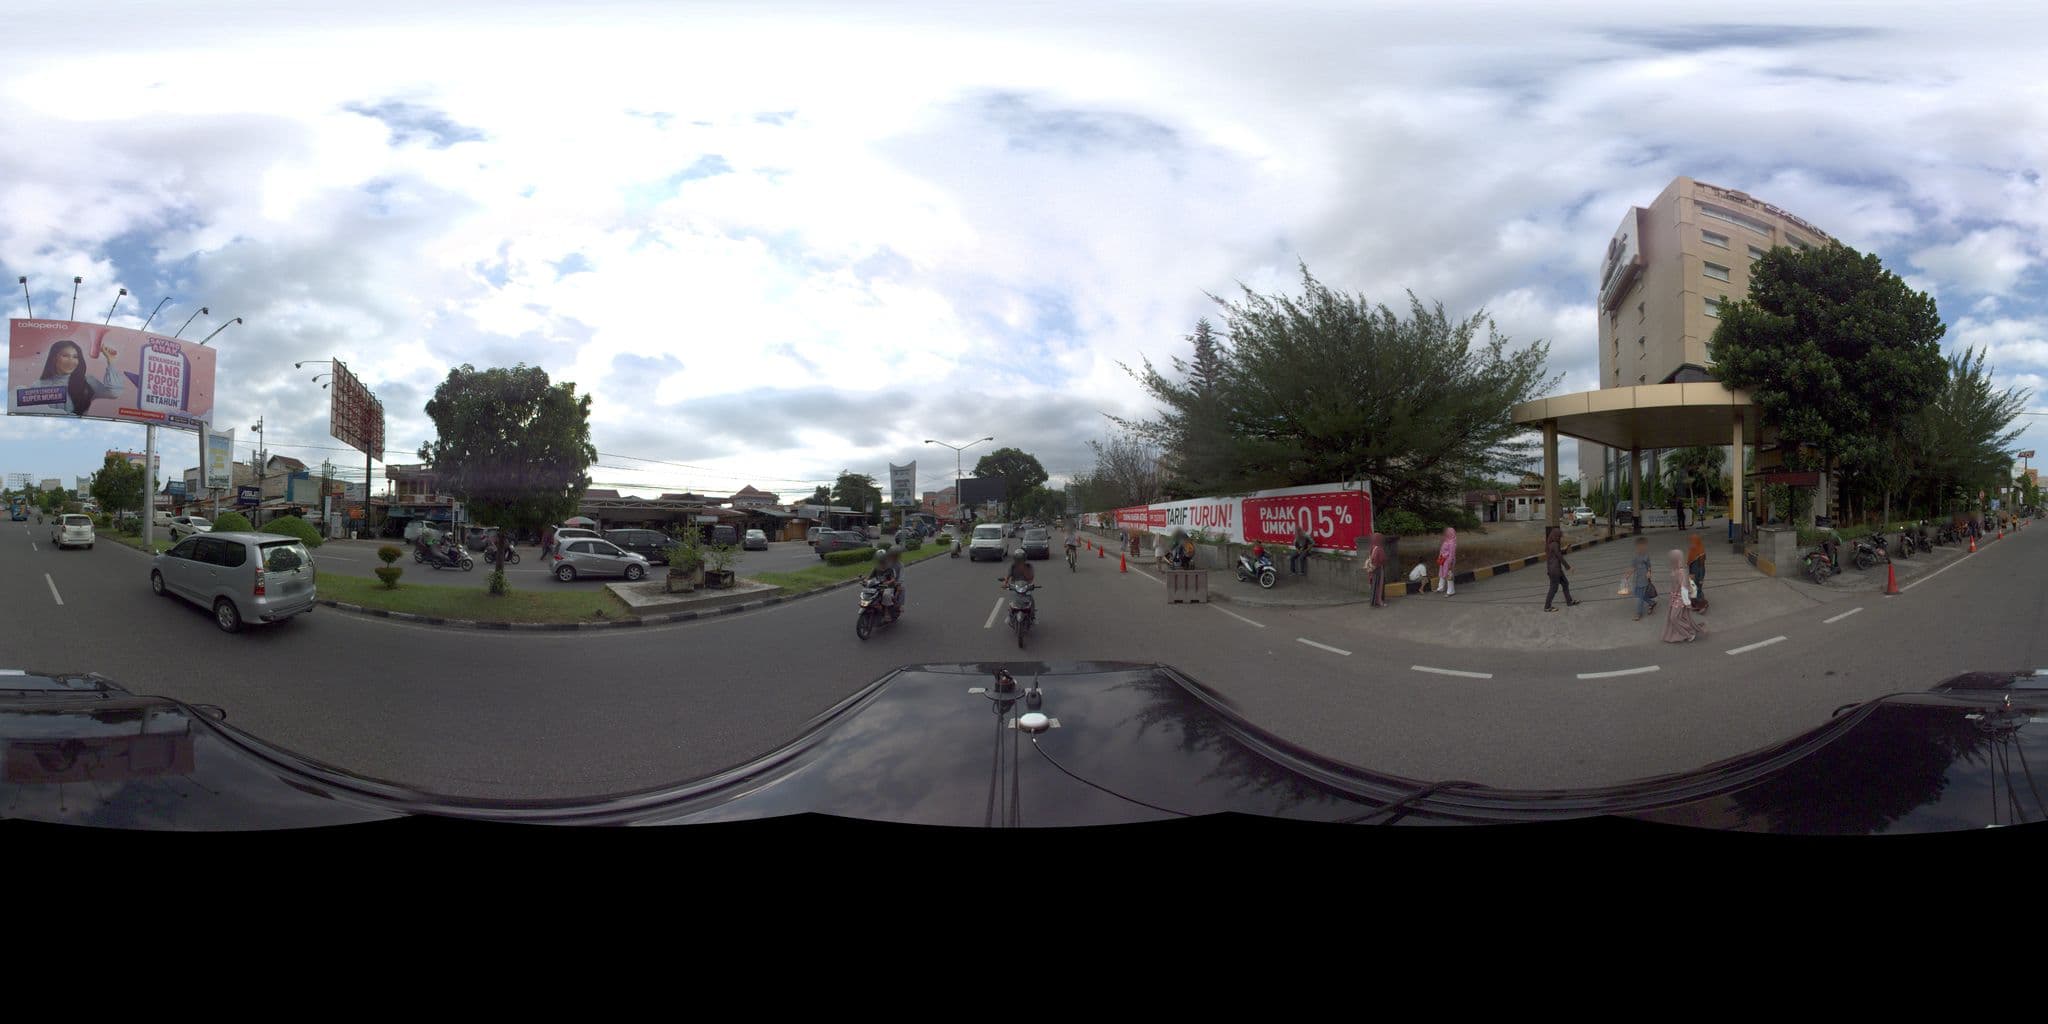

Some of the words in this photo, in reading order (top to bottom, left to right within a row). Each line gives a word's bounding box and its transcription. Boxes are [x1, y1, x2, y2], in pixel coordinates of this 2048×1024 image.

[18, 322, 68, 330] tokopedia
[148, 362, 180, 378] UANG
[147, 373, 180, 388] POPOK
[152, 385, 179, 398] SUSU
[1167, 507, 1188, 526] TARIF
[1189, 504, 1232, 528] TURUN!
[1260, 505, 1295, 521] PAJAK
[1262, 520, 1296, 535] UMKM
[1298, 505, 1352, 538] 0.5%
